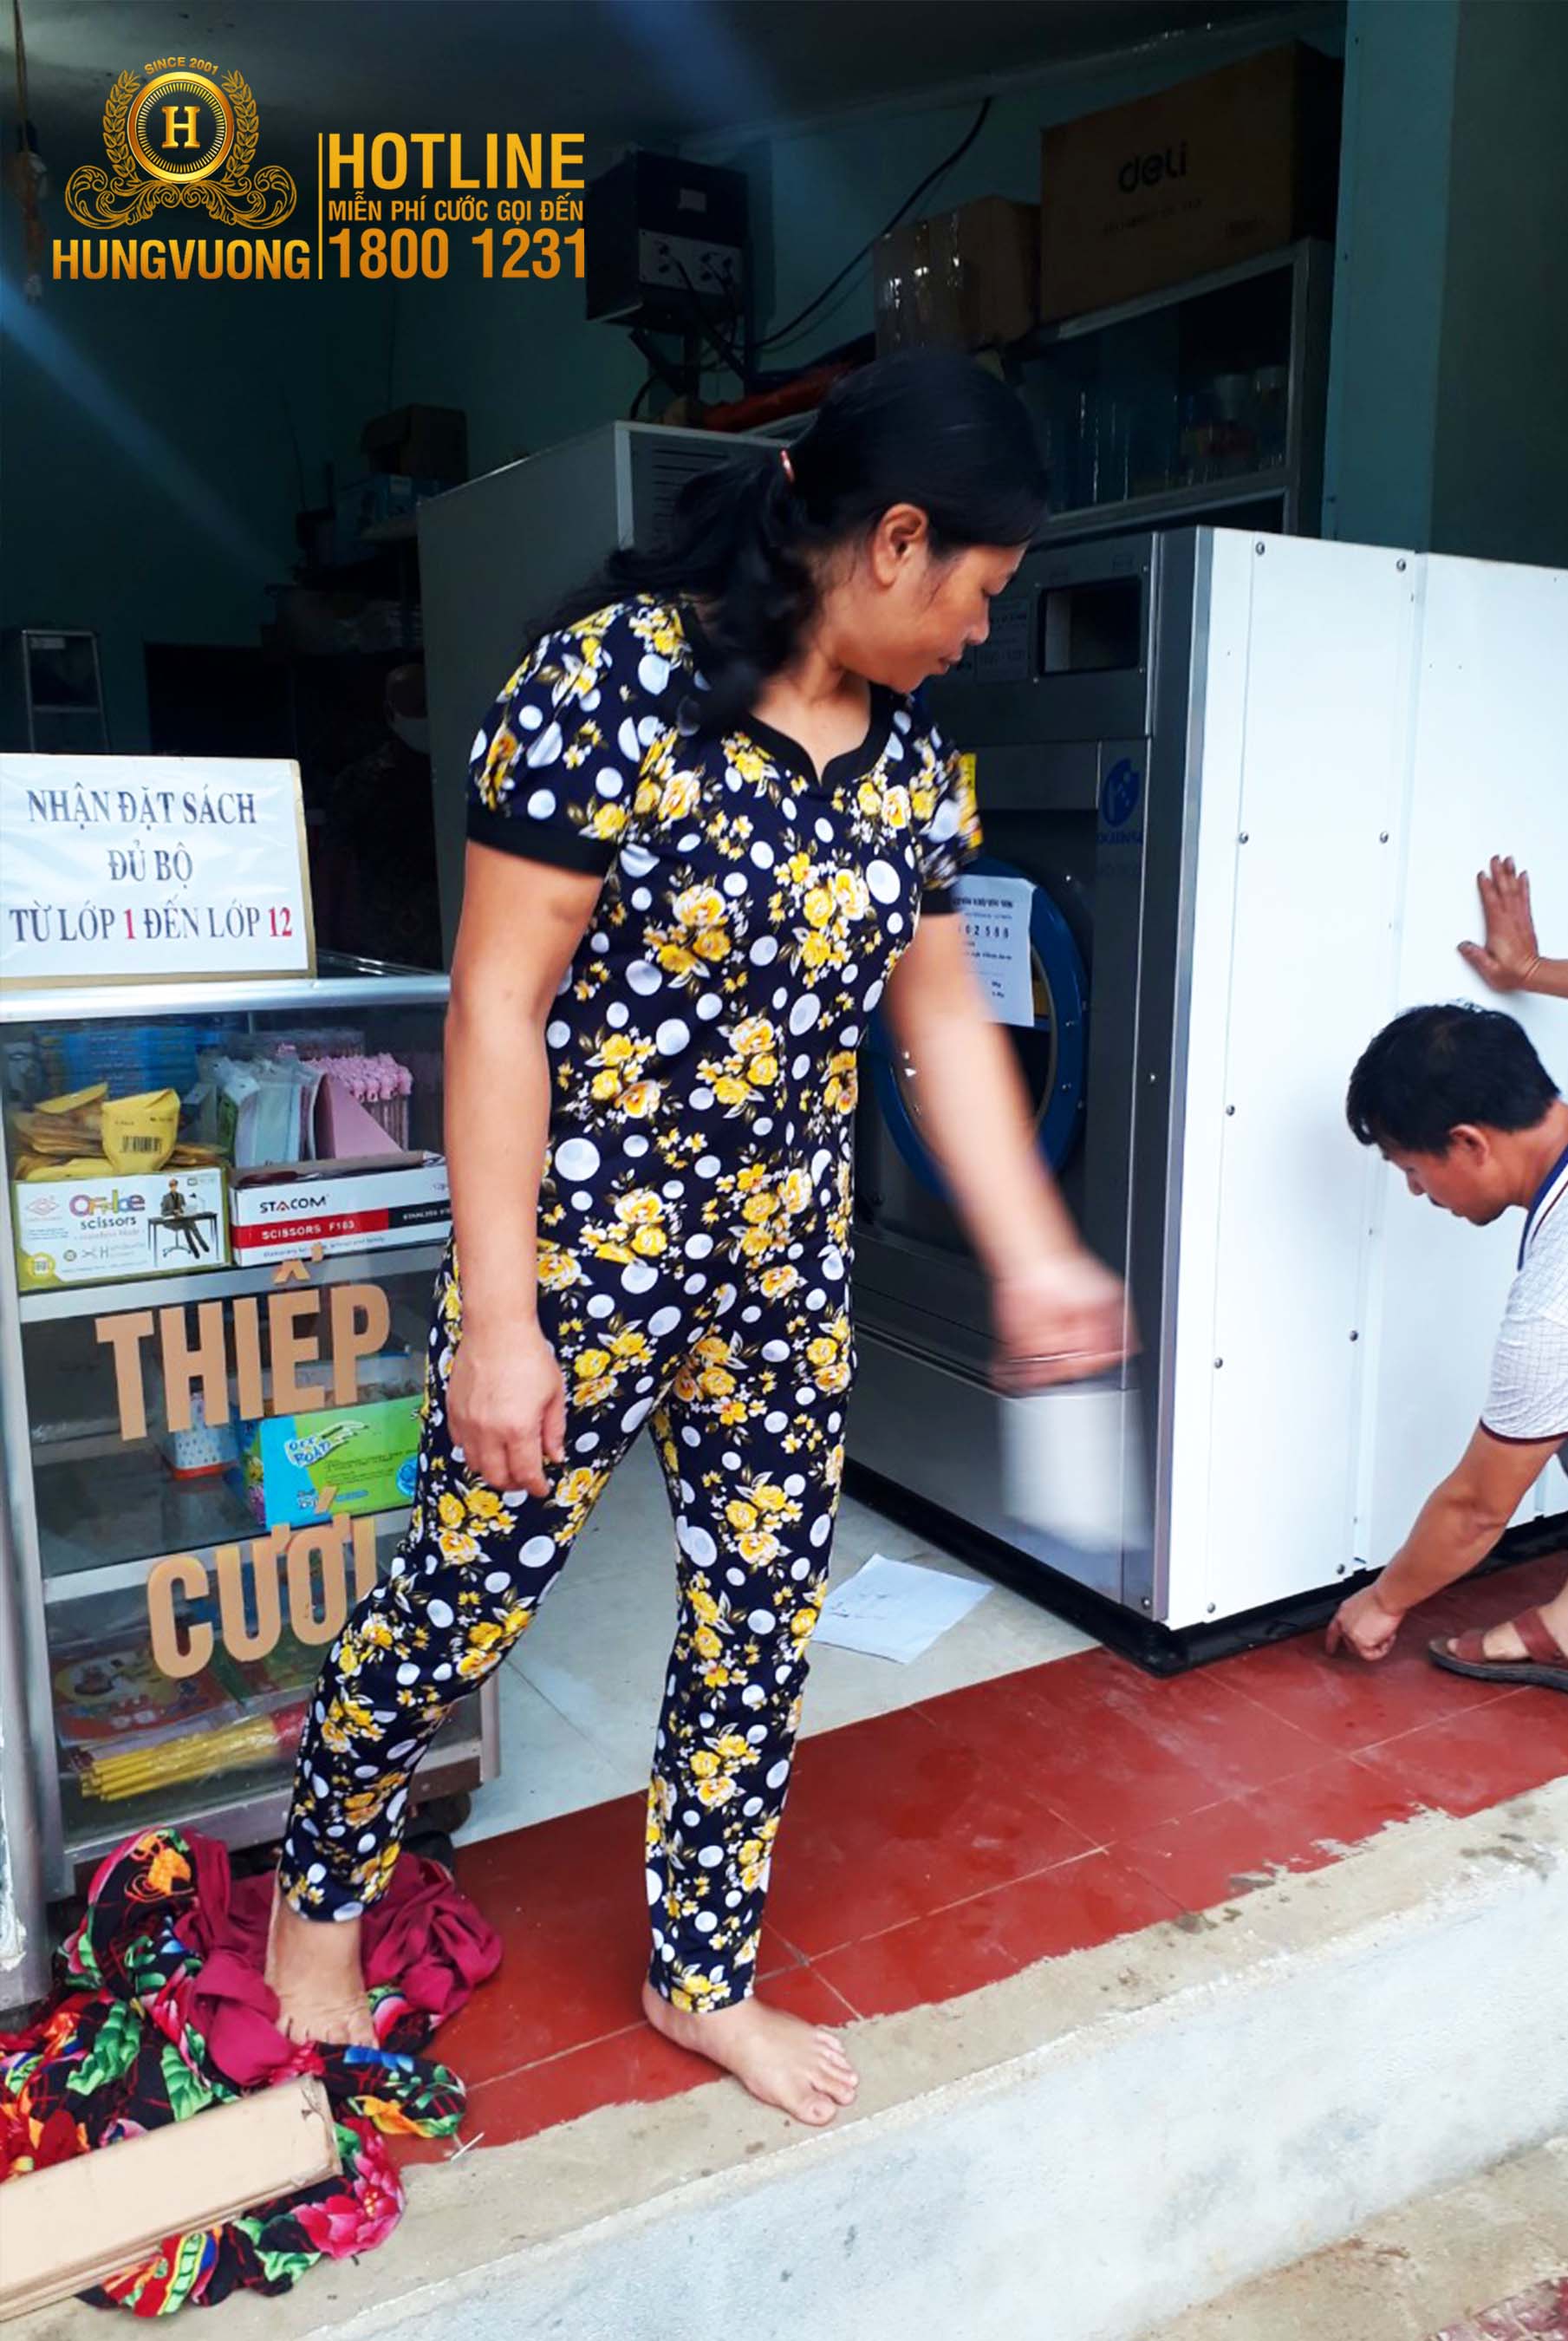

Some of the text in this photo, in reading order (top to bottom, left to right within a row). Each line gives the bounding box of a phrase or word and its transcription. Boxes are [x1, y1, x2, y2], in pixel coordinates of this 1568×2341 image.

[1117, 140, 1188, 194] deli
[26, 782, 257, 831] NHẬN ĐẶT SÁCH
[107, 838, 193, 889] ĐỦ BỘ
[10, 894, 293, 942] TỪ LỚP 1 ĐẾN LỚP 12
[81, 1214, 137, 1230] scissors
[260, 1196, 327, 1214] STACOM
[262, 1224, 322, 1240] SCISSORS
[147, 1485, 378, 1679] CƯỚI
